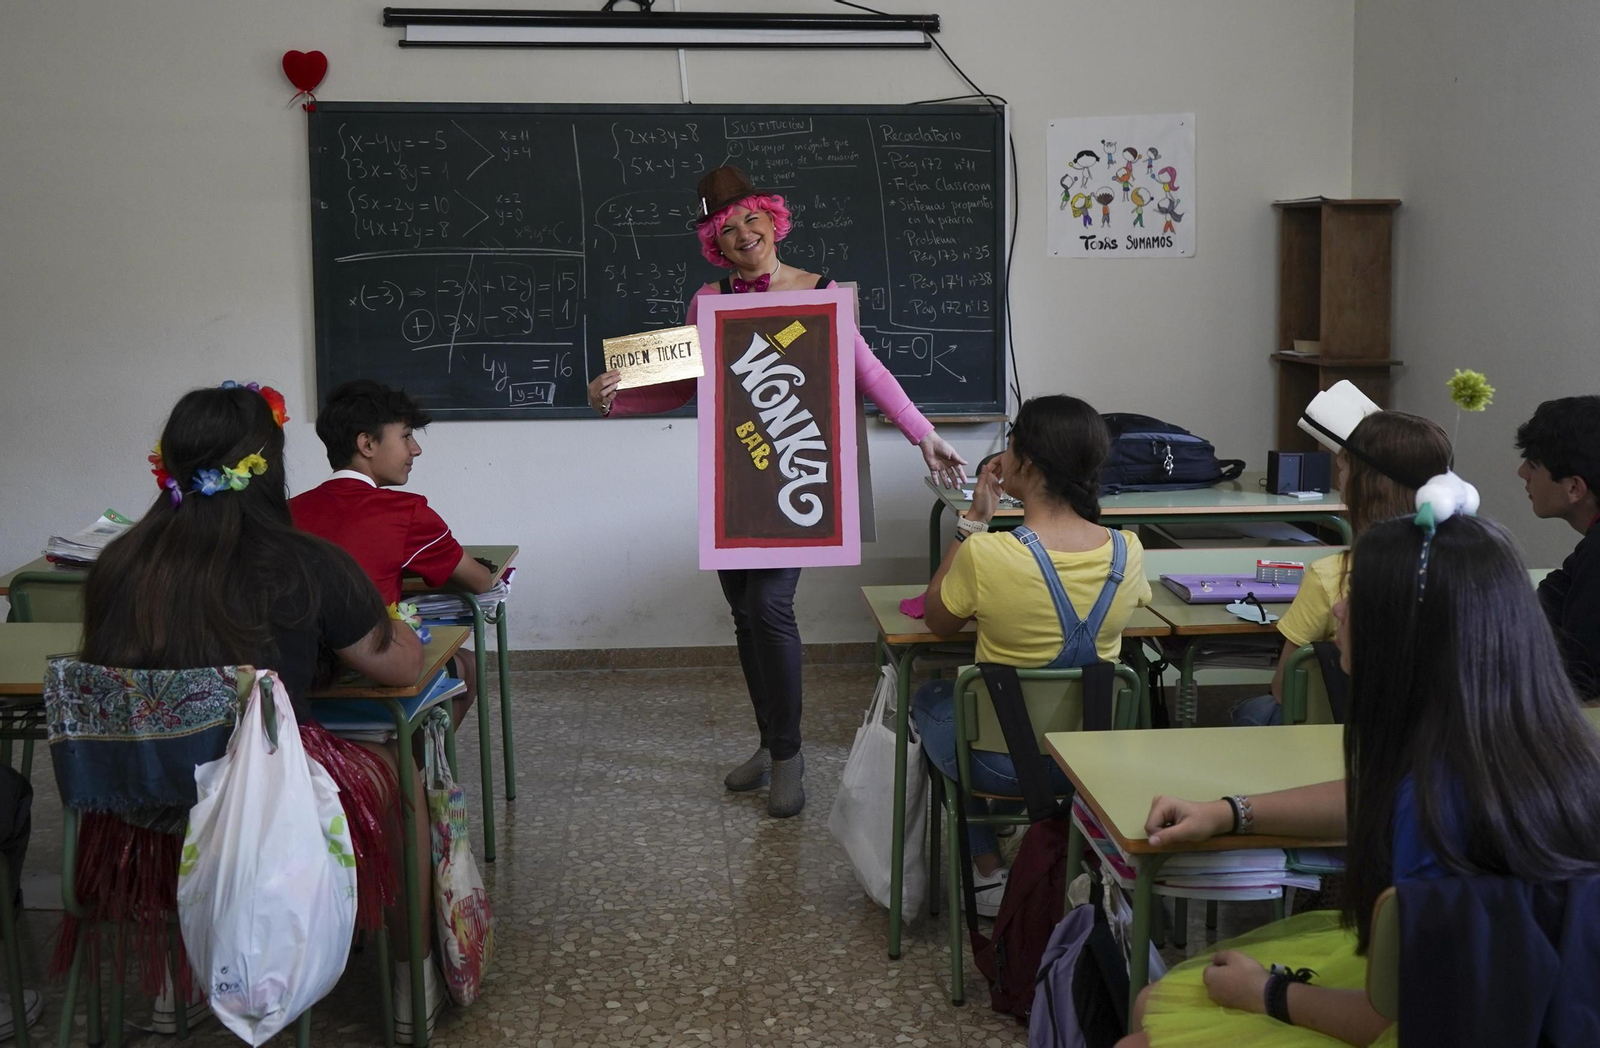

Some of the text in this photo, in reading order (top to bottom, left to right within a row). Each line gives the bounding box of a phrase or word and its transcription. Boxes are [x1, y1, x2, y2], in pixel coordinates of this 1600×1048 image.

[1126, 234, 1173, 251] SUMAMOS
[609, 341, 692, 370] GOLDEN TICKET
[730, 331, 828, 528] WONKA
[735, 420, 771, 471] BAR
